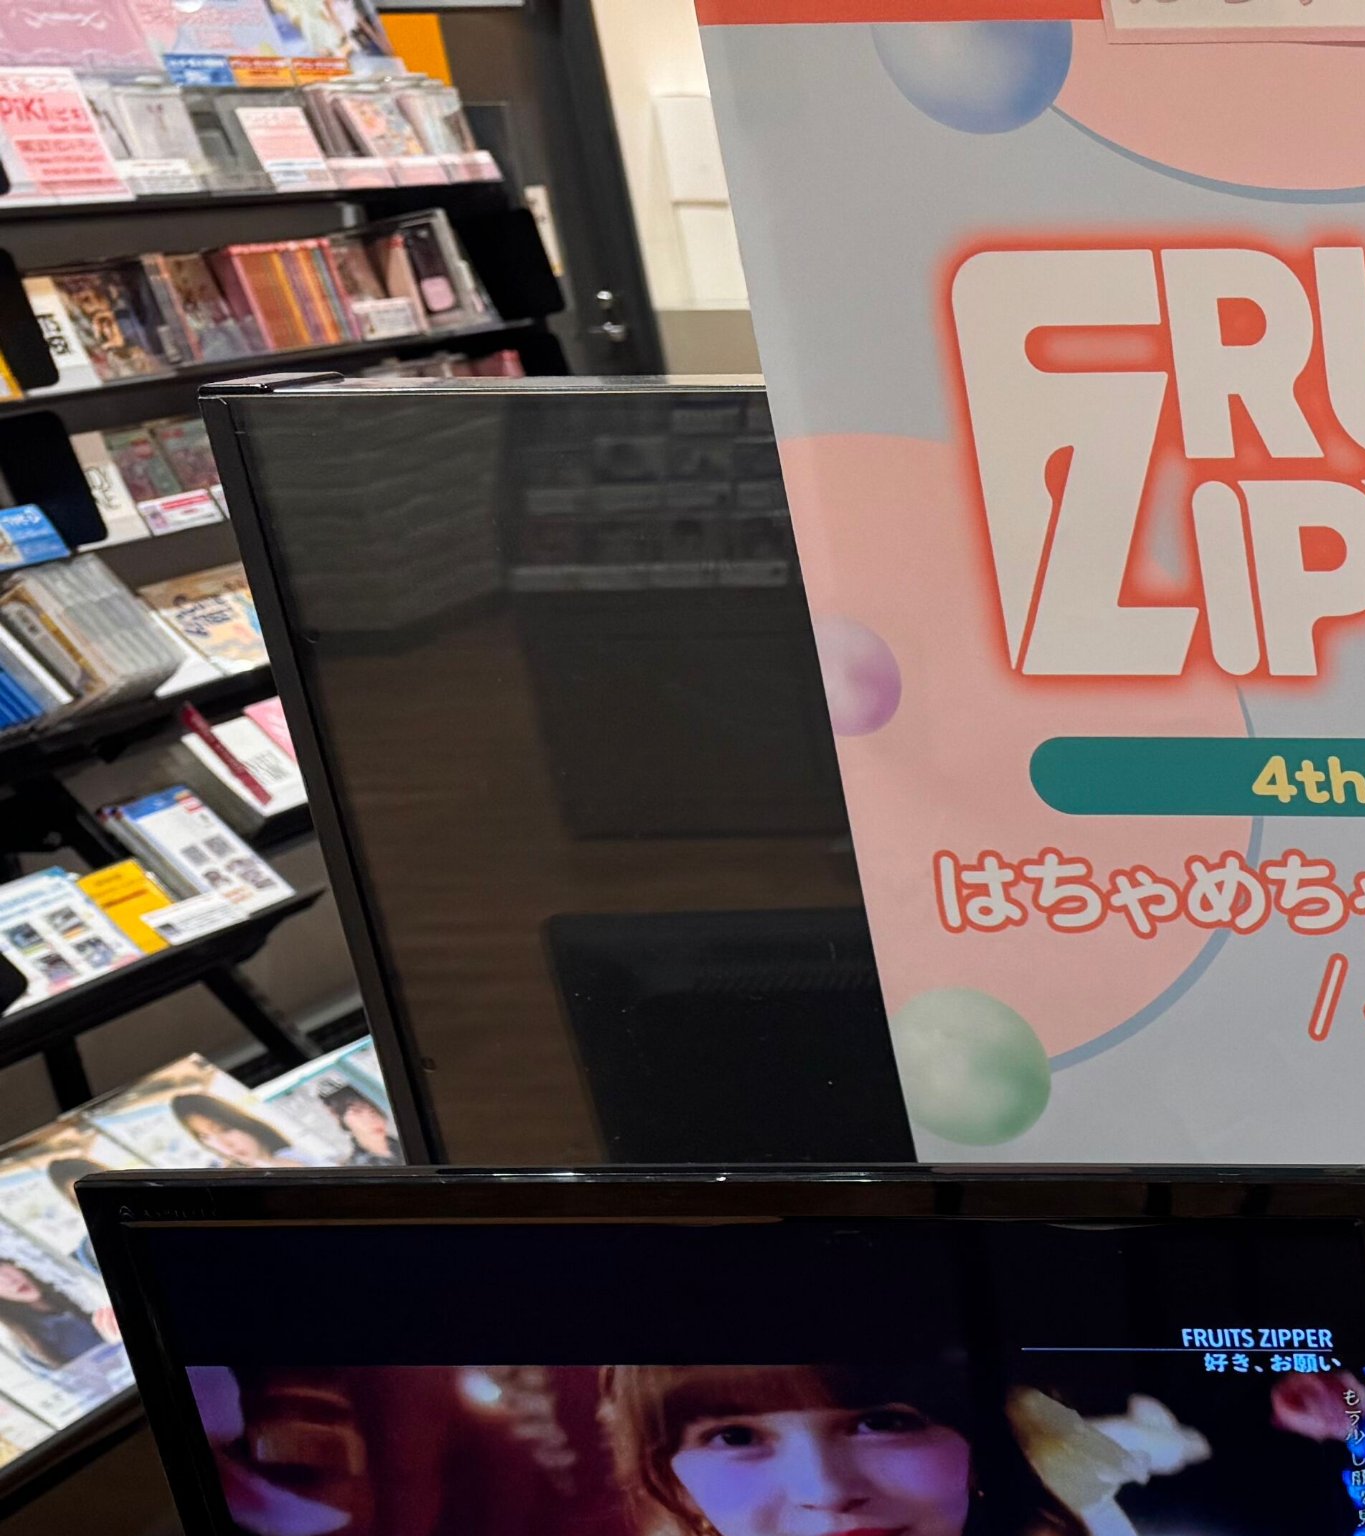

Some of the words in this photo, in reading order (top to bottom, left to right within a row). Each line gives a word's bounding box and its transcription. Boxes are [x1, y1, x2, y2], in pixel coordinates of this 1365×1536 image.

[1307, 952, 1348, 1041] /
[1181, 1328, 1254, 1348] FRUITS
[1259, 1329, 1333, 1348] ZIPPER
[1204, 1353, 1342, 1373] 好き、お願い
